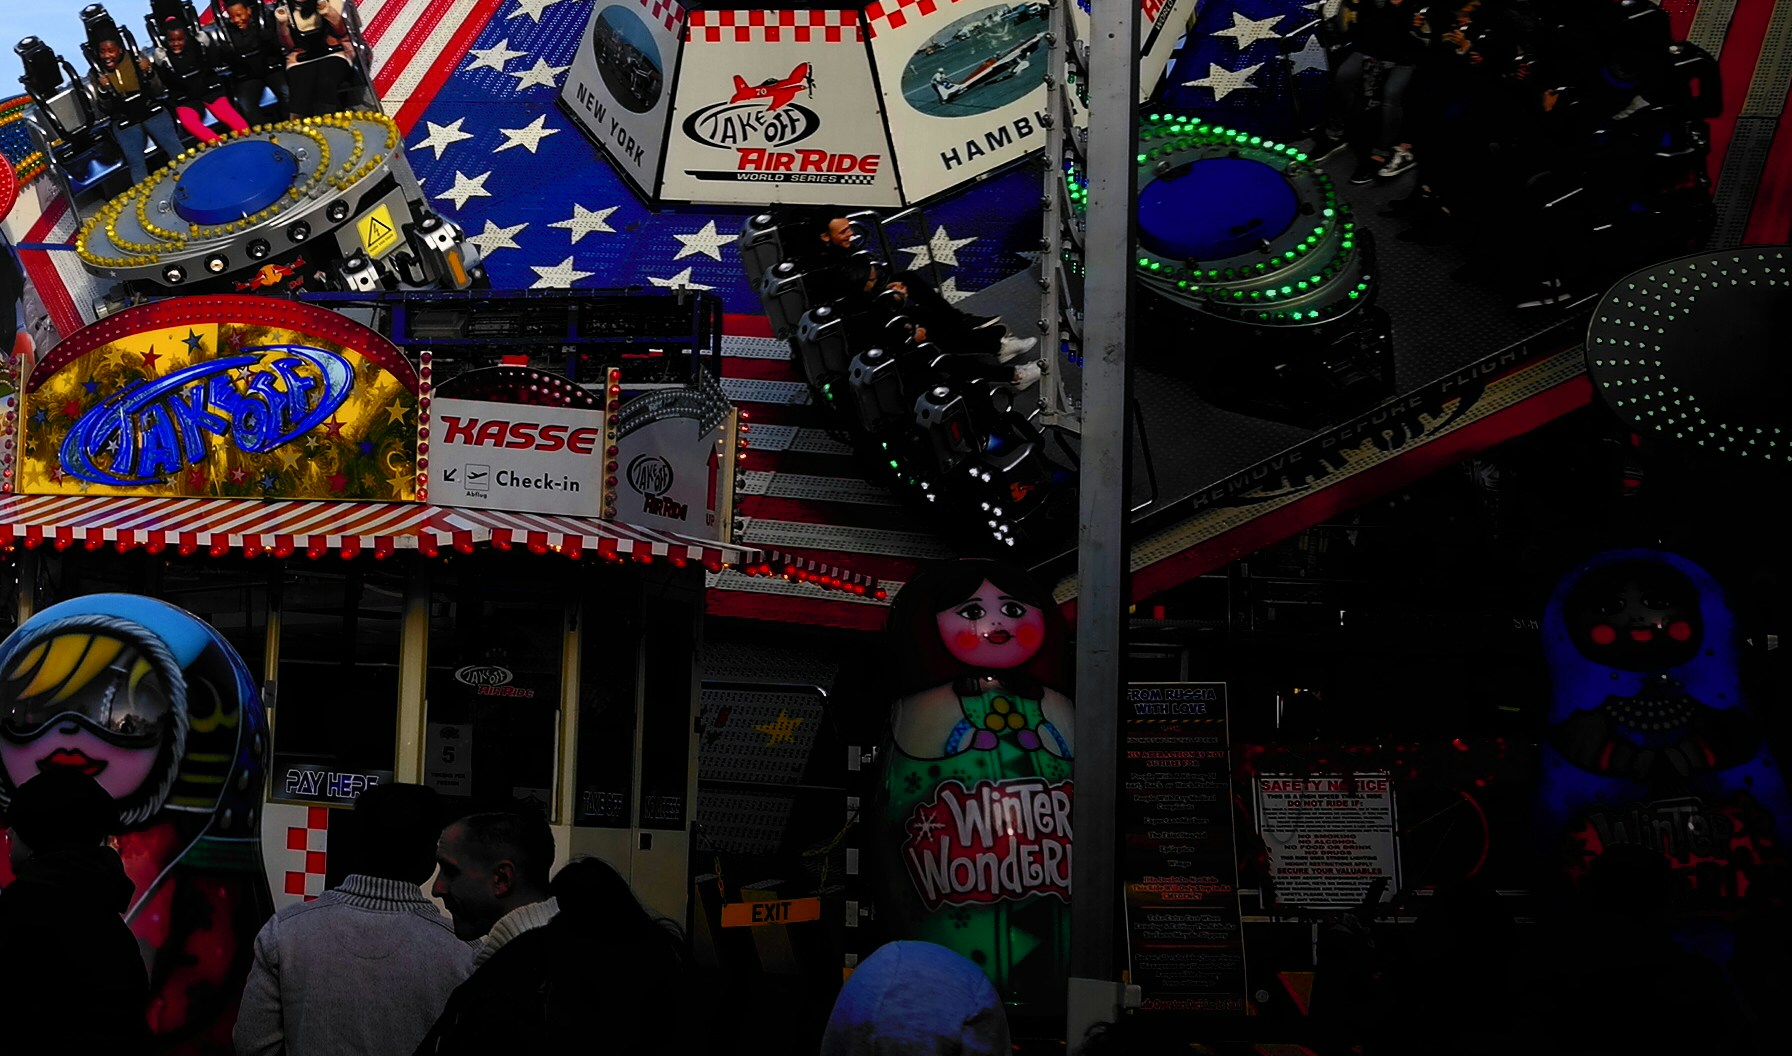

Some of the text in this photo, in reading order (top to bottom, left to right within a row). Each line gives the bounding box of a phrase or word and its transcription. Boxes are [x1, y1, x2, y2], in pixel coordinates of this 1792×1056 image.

[755, 88, 767, 96] 70
[576, 82, 645, 167] NEW YORK
[700, 104, 800, 144] TAKE OFF
[736, 148, 880, 174] AIR RIDE
[736, 173, 837, 183] WORLD SERIES
[441, 416, 599, 455] KASSE
[496, 470, 580, 493] Check-in
[633, 458, 657, 490] TAKE
[466, 490, 488, 499] Abflug
[706, 513, 715, 526] UP
[462, 666, 490, 684] TAKE
[442, 746, 455, 763] 5
[286, 769, 325, 795] PAY
[1261, 780, 1323, 791] SAFETY
[752, 902, 791, 922] EXIT
